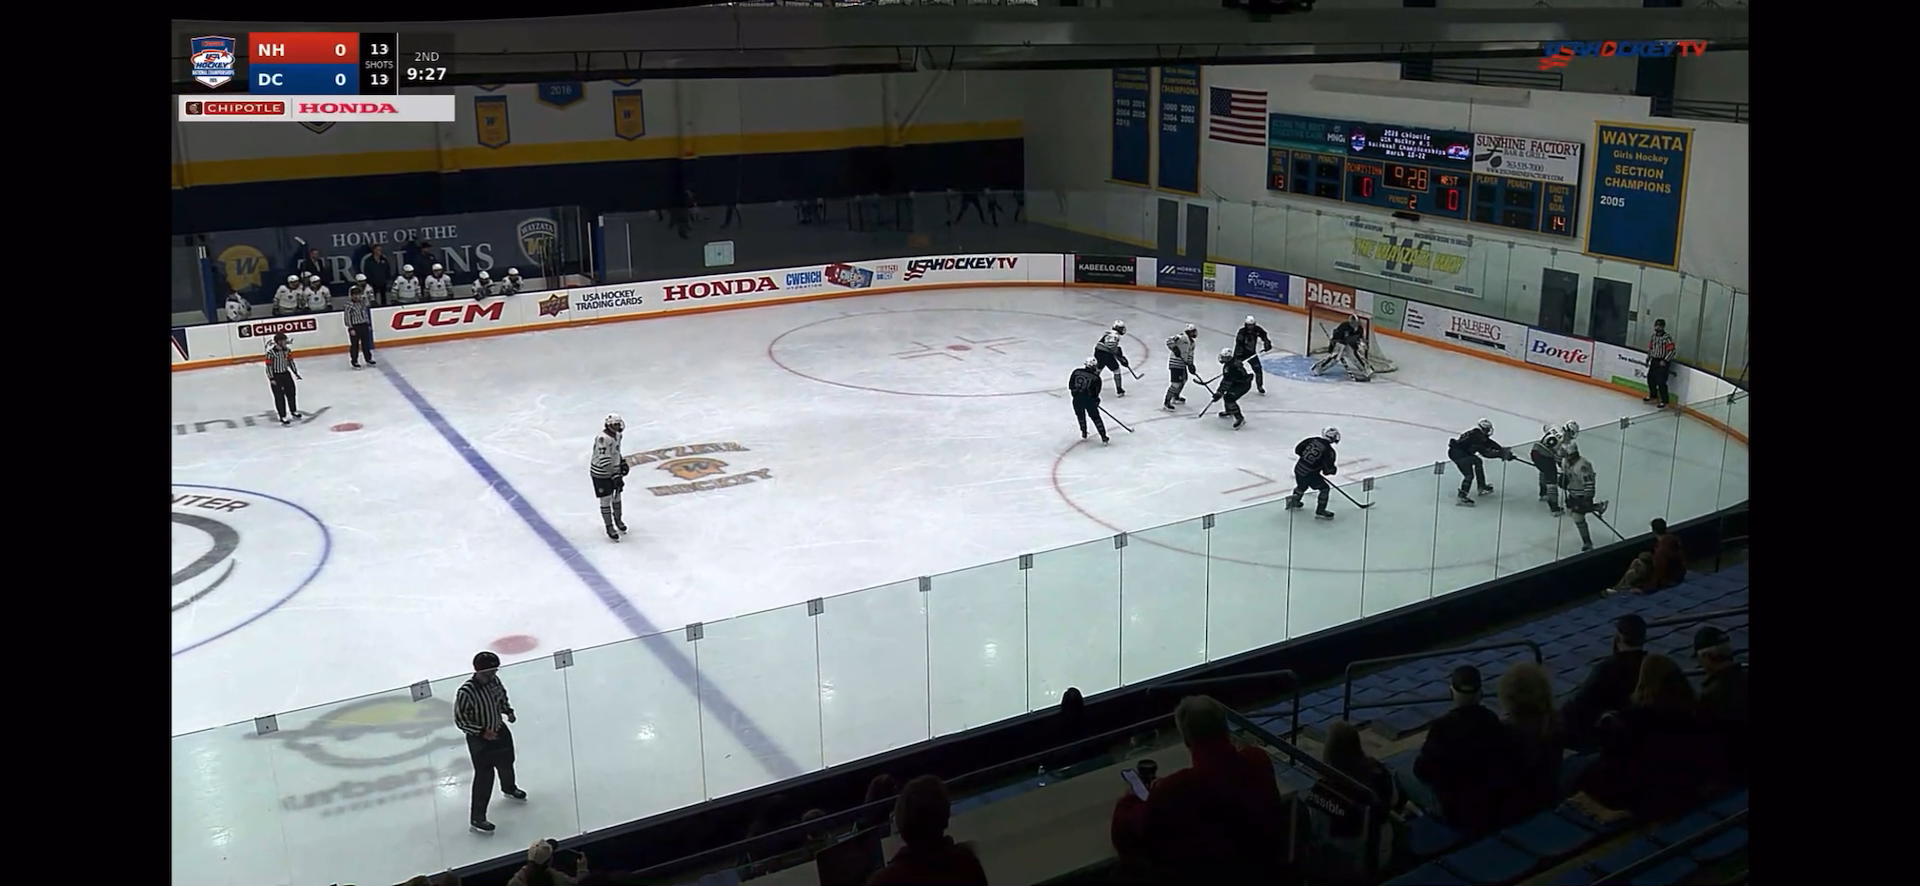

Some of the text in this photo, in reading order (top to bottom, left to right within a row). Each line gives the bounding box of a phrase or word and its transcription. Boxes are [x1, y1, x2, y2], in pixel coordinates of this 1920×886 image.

[1162, 84, 1199, 95] CHAMPIONS
[1476, 135, 1579, 156] SUNSHINE FACTORY
[1602, 130, 1684, 151] WAYZATA
[1368, 141, 1446, 156] National Championships
[1525, 151, 1547, 159] GRILL
[1613, 150, 1669, 165] Girls Hockey
[1615, 164, 1664, 179] SECTION
[1362, 177, 1372, 197] 0
[1507, 179, 1533, 190] PENALTY
[1605, 177, 1671, 193] CHAMPIONS
[1409, 194, 1417, 209] 2
[1448, 189, 1459, 210] 0
[1600, 195, 1625, 207] 2005
[521, 222, 554, 235] WAYZATA
[1552, 215, 1566, 232] 14
[331, 225, 458, 248] HOME OF THE
[1079, 263, 1134, 272] KABEELO.COM
[786, 271, 822, 286] CWENCH
[583, 289, 635, 302] USA HOCKEY
[663, 276, 779, 301] HONDA
[1307, 282, 1351, 308] Blaze
[576, 300, 614, 311] TRADING
[615, 297, 643, 307] CARDS
[391, 302, 505, 330] CCM
[255, 320, 314, 334] CHIPOTLE
[1451, 316, 1501, 340] HALBERG
[1532, 340, 1588, 364] Bonfe
